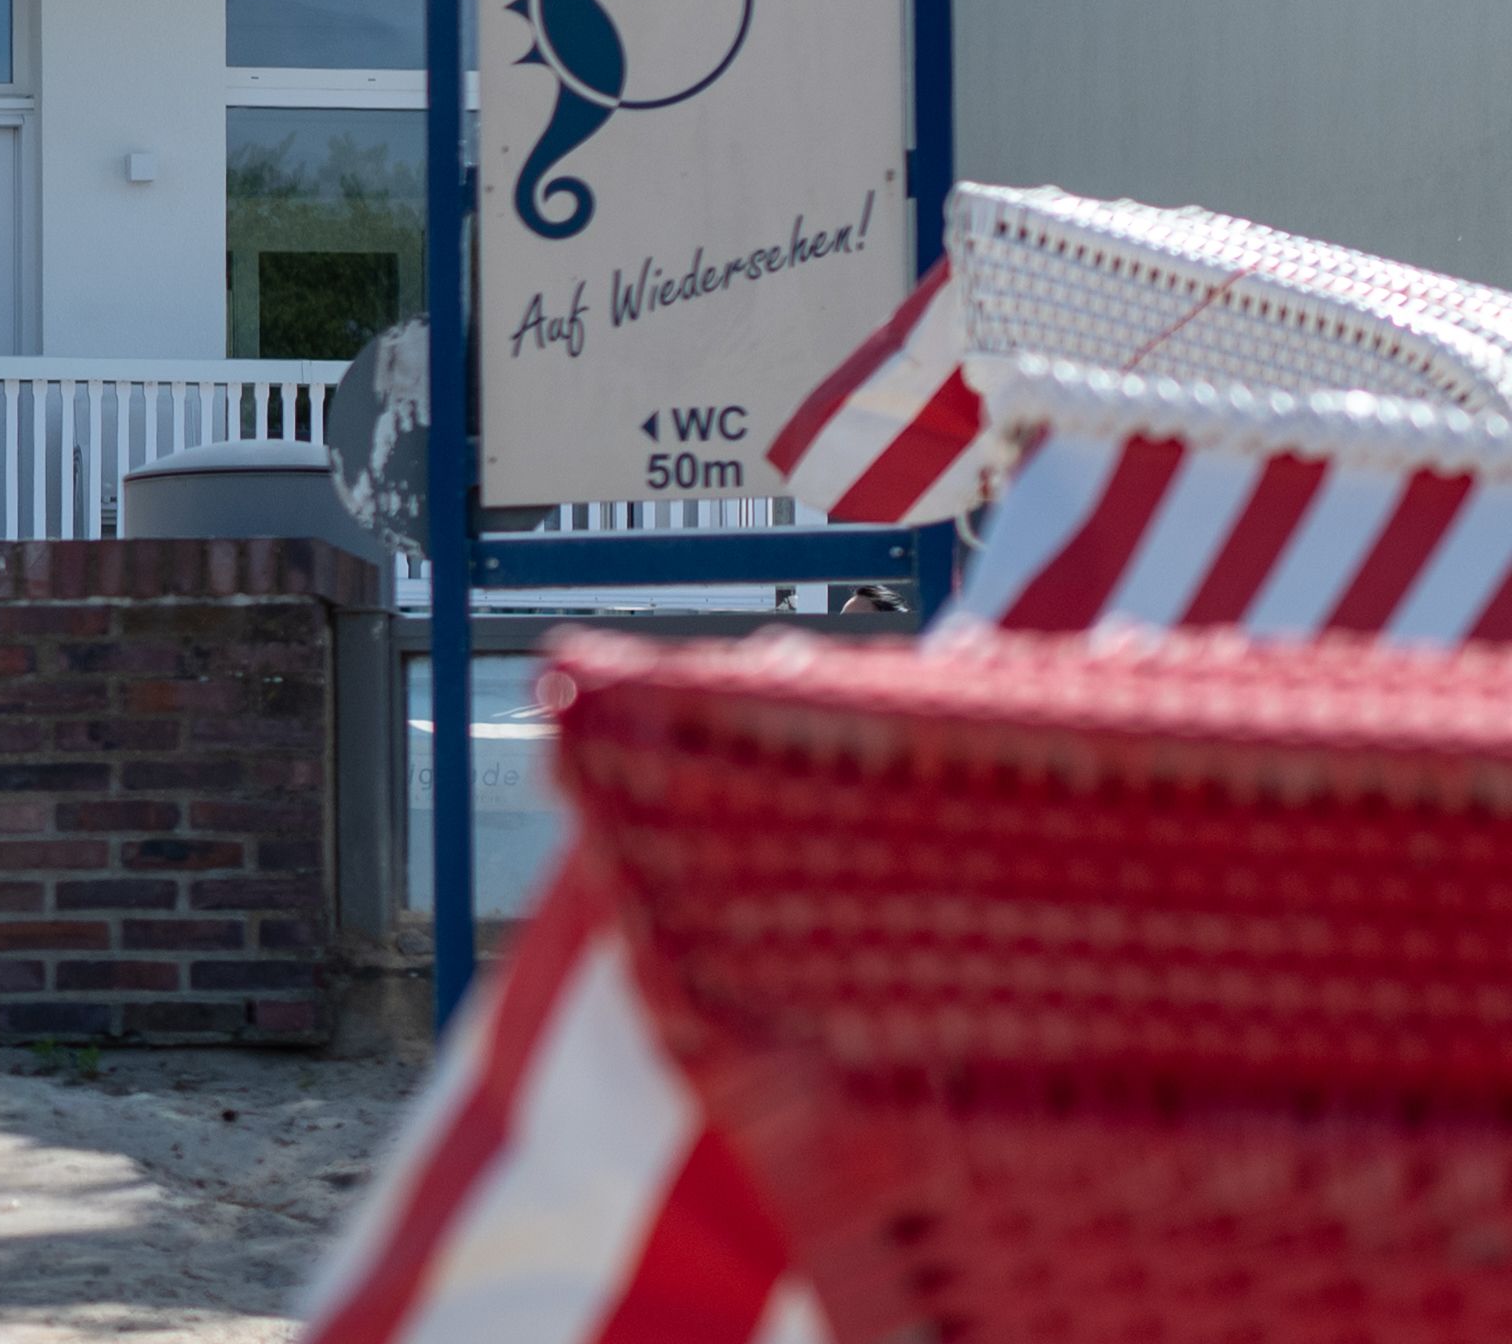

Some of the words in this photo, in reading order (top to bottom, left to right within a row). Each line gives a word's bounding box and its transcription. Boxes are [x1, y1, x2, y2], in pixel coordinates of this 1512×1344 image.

[509, 280, 590, 358] Auf
[610, 189, 876, 328] Wiedersehen!
[671, 405, 749, 442] WC
[645, 452, 744, 489] 50m
